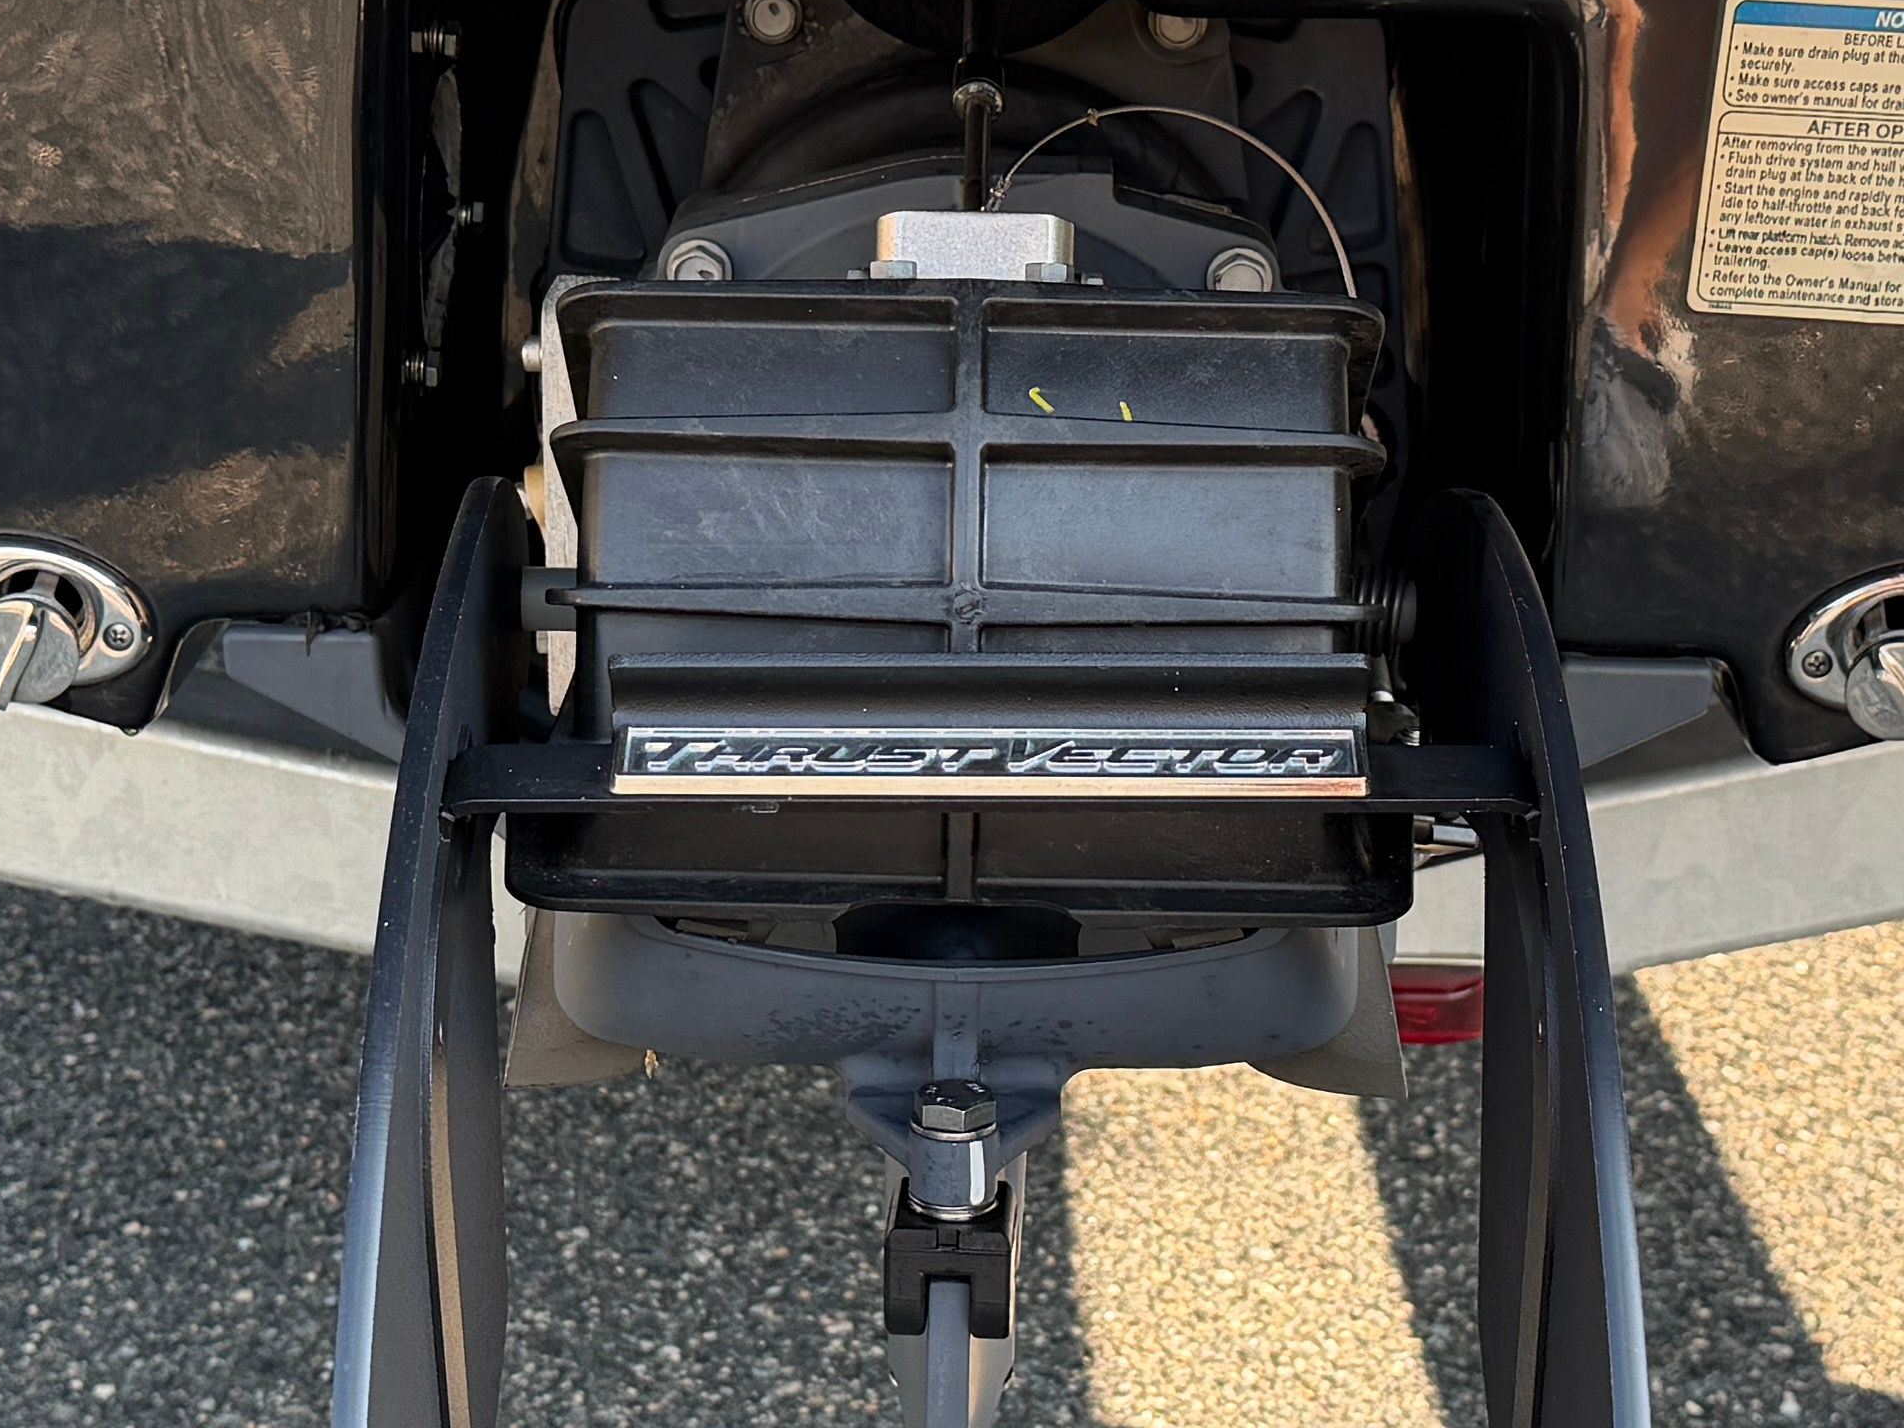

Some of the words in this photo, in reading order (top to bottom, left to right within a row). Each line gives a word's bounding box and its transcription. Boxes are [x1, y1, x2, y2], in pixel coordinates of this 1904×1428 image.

[1844, 33, 1894, 47] BEFORE
[1742, 43, 1774, 56] Make
[1778, 47, 1804, 58] sure
[1808, 47, 1839, 59] drain
[1842, 49, 1870, 65] plug
[1874, 51, 1885, 62] at
[1740, 59, 1794, 75] securely.
[1738, 73, 1769, 87] Make
[1774, 78, 1800, 88] sure
[1803, 80, 1845, 91] access
[1850, 82, 1878, 95] caps
[1882, 84, 1901, 94] are
[1736, 89, 1758, 102] See
[1762, 93, 1809, 105] owner's
[1813, 96, 1858, 108] manual
[1861, 96, 1879, 109] for
[1807, 121, 1870, 137] AFTER
[1722, 137, 1752, 149] After
[1755, 140, 1812, 156] removing
[1816, 142, 1844, 154] from
[1848, 144, 1867, 156] the
[1728, 151, 1762, 165] Flush
[1766, 154, 1796, 167] drive
[1799, 156, 1843, 172] system
[1847, 159, 1870, 171] and
[1873, 160, 1896, 172] hull
[1726, 166, 1756, 178] drain
[1760, 169, 1786, 183] plug
[1790, 171, 1801, 181] at
[1805, 171, 1823, 182] the
[1828, 172, 1856, 184] back
[1860, 174, 1873, 185] of
[1876, 175, 1895, 186] the
[1724, 182, 1753, 195] Start
[1757, 184, 1775, 196] the
[1778, 186, 1819, 202] engine
[1823, 189, 1846, 200] and
[1849, 189, 1891, 206] rapidly
[1721, 197, 1743, 209] idle
[1747, 199, 1758, 210] to
[1762, 199, 1832, 214] half-throttle
[1836, 204, 1858, 215] and
[1861, 205, 1890, 217] back
[1720, 213, 1742, 226] any
[1744, 212, 1791, 225] leftover
[1795, 217, 1828, 228] water
[1830, 217, 1841, 228] in
[1845, 219, 1893, 232] exhaust
[1719, 228, 1736, 239] Lift
[1738, 231, 1760, 240] rear
[1761, 231, 1807, 245] platform
[1809, 233, 1842, 245] hatch.
[1845, 236, 1890, 248] Remove
[1717, 242, 1752, 254] Leave
[1756, 246, 1797, 256] access
[1801, 247, 1839, 260] cap(s)
[1842, 249, 1874, 261] loose
[1714, 255, 1770, 271] trailering.
[1713, 270, 1745, 283] Refer
[1748, 273, 1759, 284] to
[1764, 273, 1782, 286] the
[1786, 275, 1834, 289] Owner's
[1838, 278, 1882, 292] Manual
[1885, 281, 1902, 293] for
[1710, 286, 1764, 301] complete
[1768, 289, 1844, 303] maintenance
[1848, 294, 1871, 305] and
[645, 740, 997, 772] THRUST
[1007, 740, 1341, 772] VECTOR
